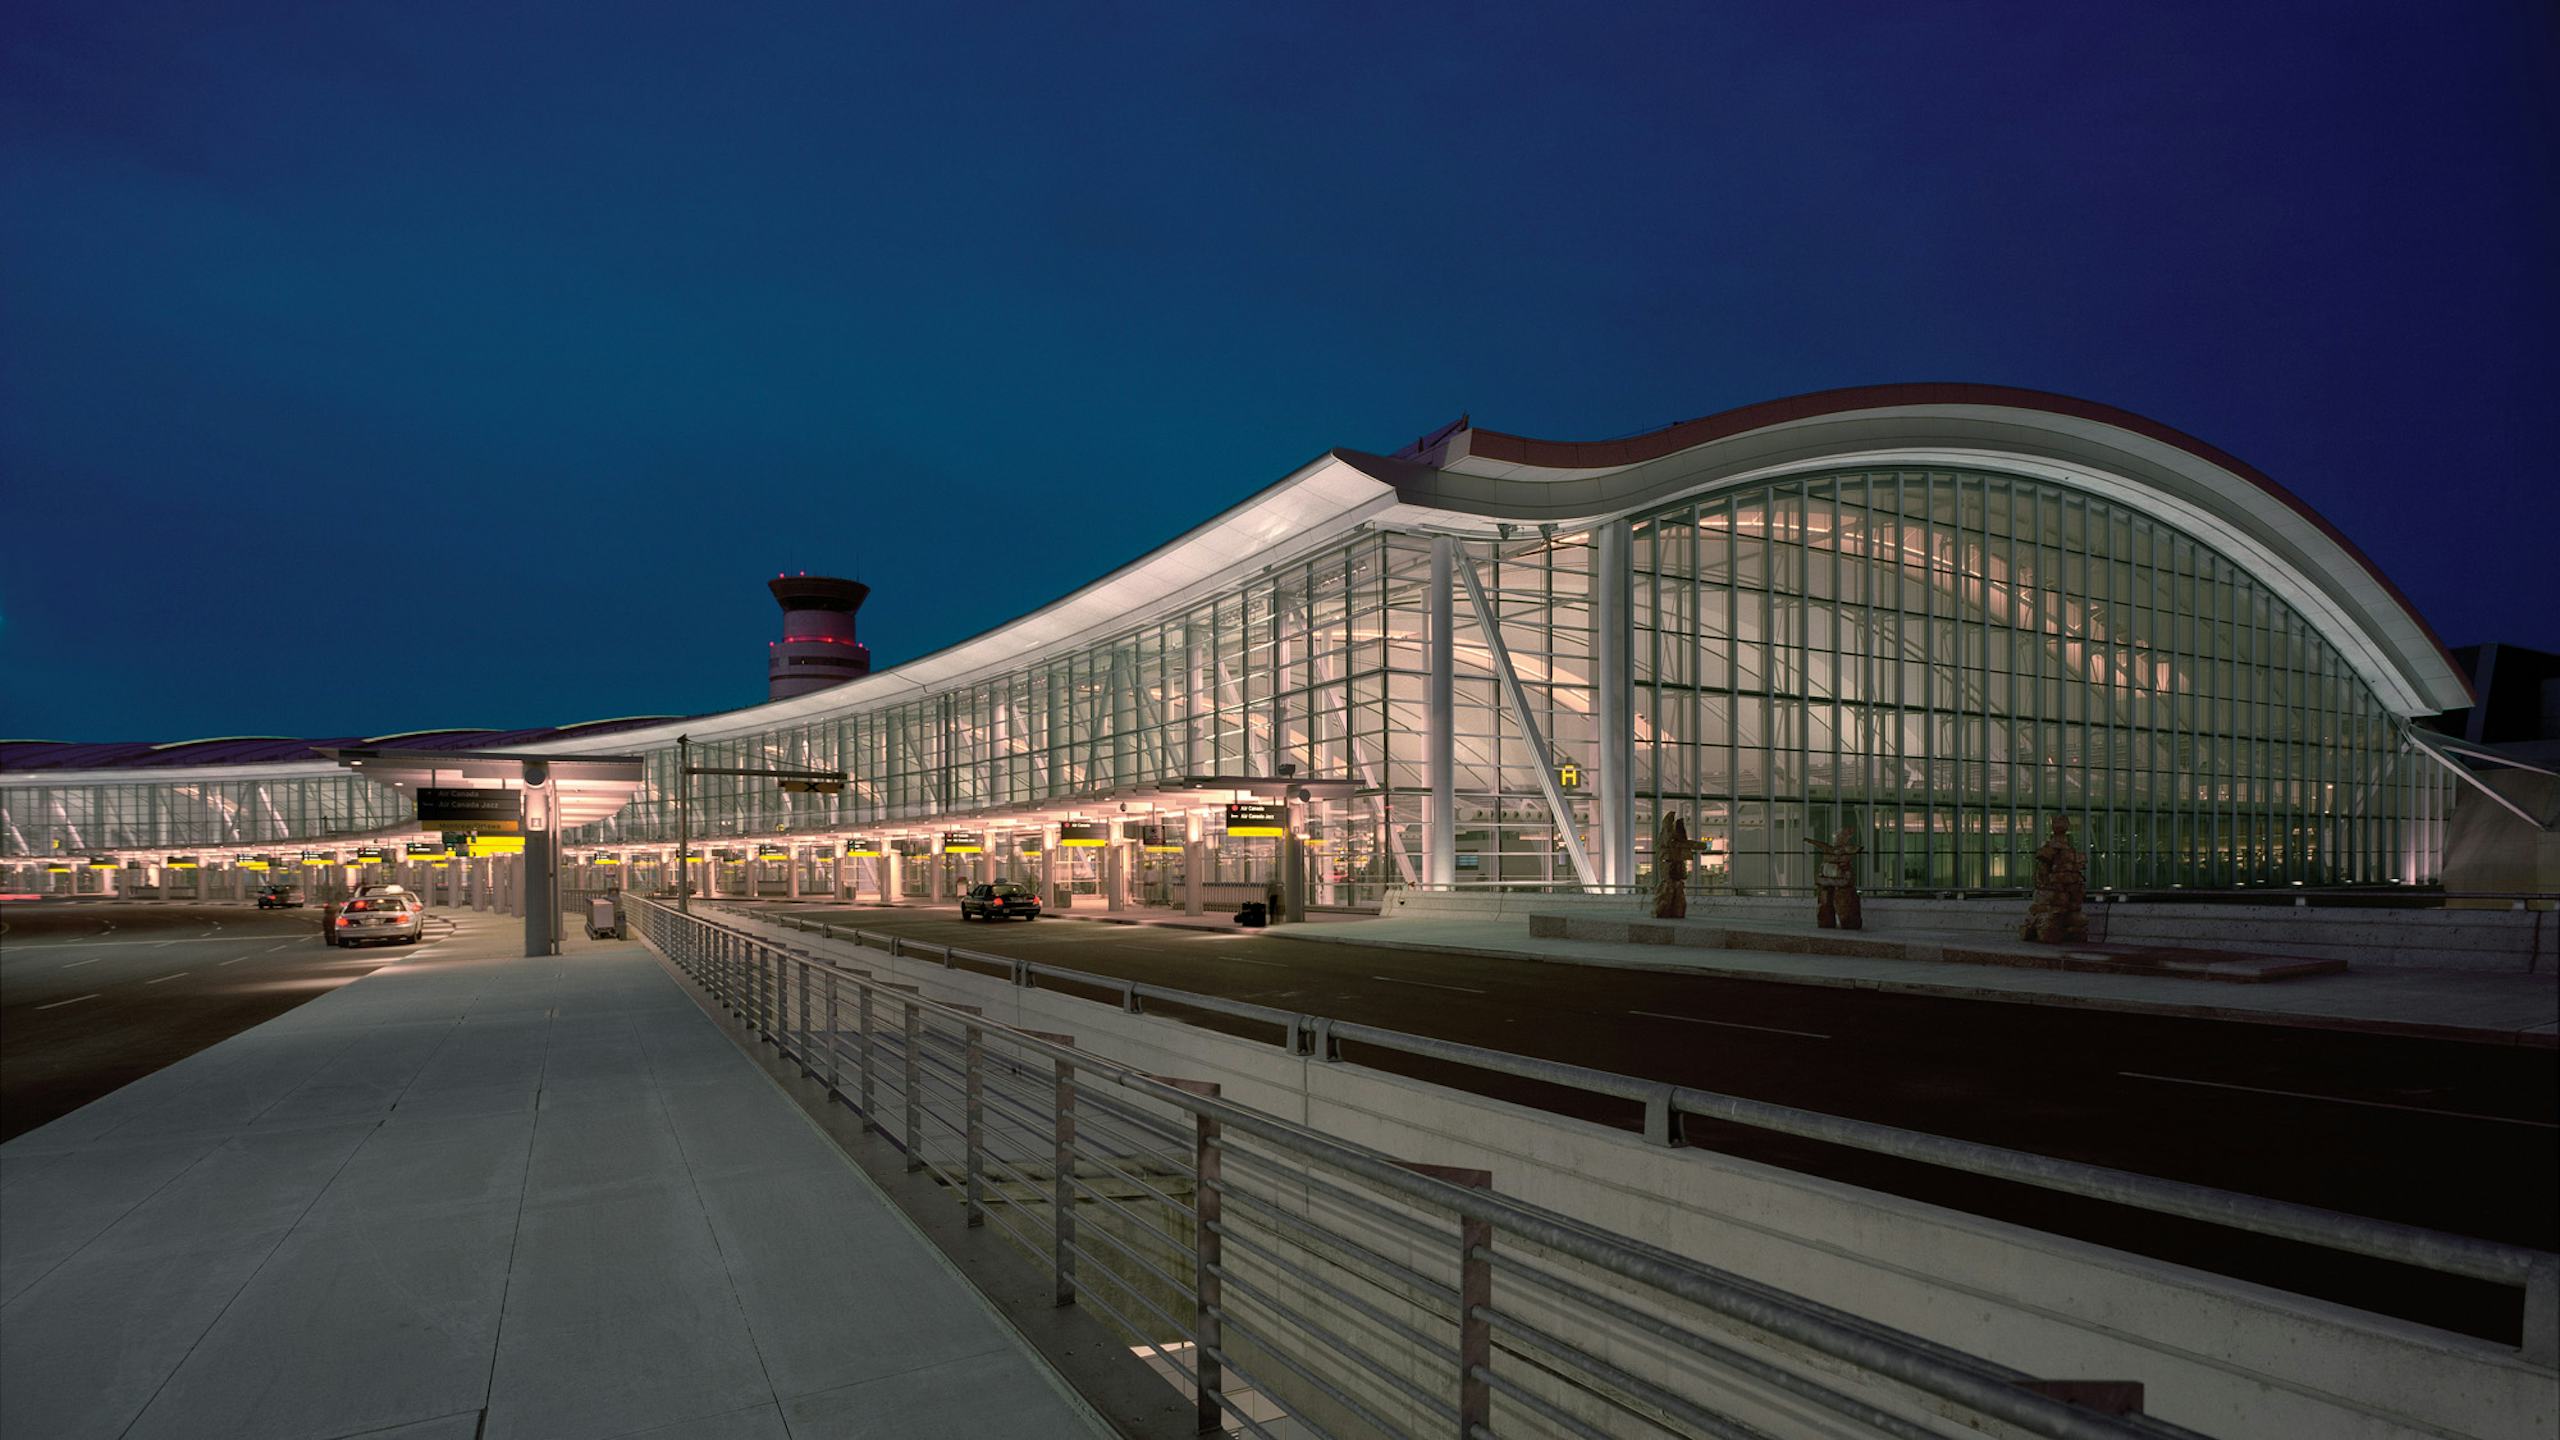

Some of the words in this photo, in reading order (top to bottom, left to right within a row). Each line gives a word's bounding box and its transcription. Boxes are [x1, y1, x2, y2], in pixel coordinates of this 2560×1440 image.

[438, 790, 449, 798] Air
[451, 790, 479, 798] Canada
[438, 801, 449, 809] Air
[451, 801, 479, 809] Canada
